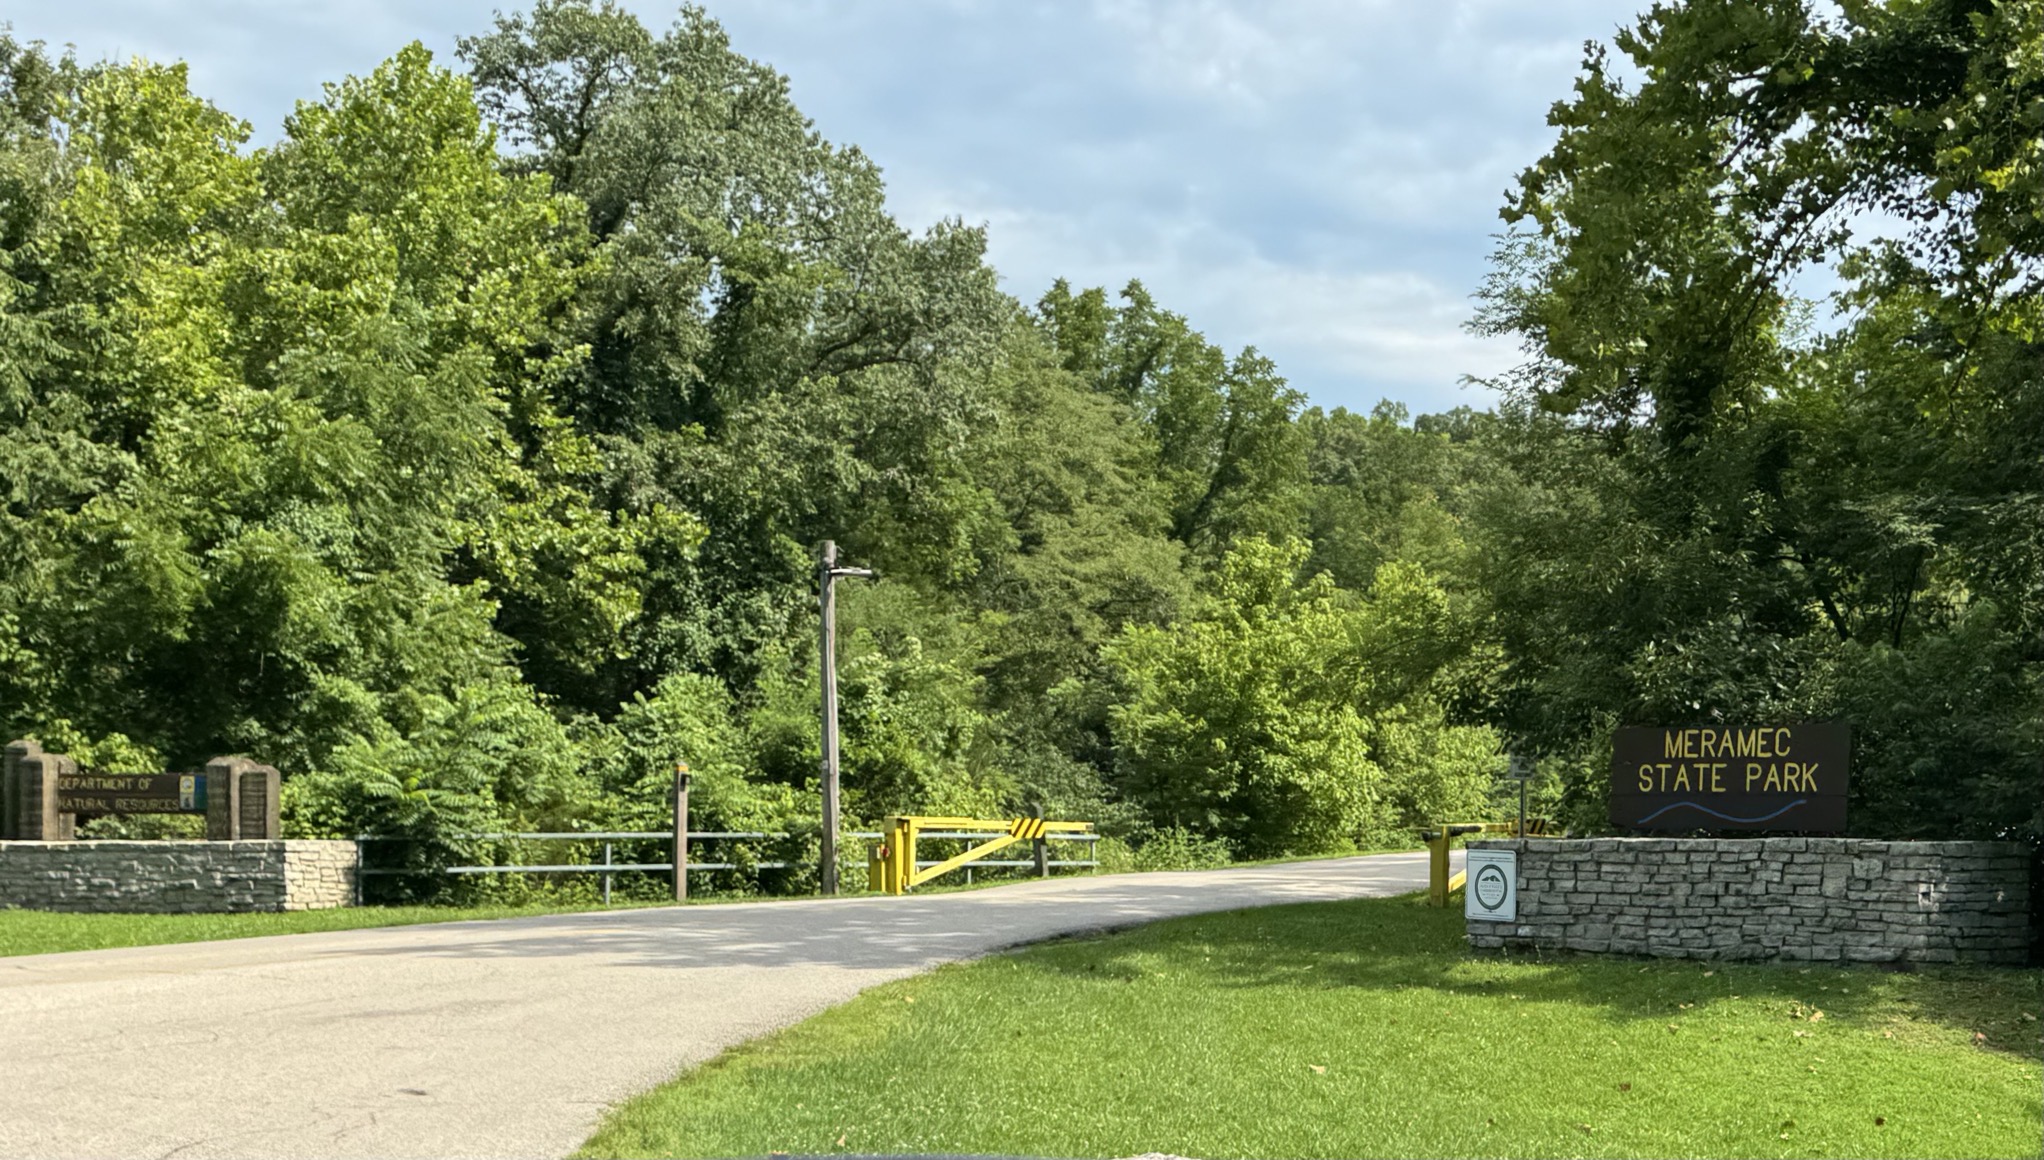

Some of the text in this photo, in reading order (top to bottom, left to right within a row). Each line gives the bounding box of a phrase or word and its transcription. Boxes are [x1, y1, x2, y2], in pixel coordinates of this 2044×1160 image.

[1664, 728, 1791, 759] MERAMEC
[59, 777, 152, 790] DEPARTMENT OF
[1638, 762, 1819, 792] STATE PARK
[58, 798, 179, 811] NATURAL RESOURCES
